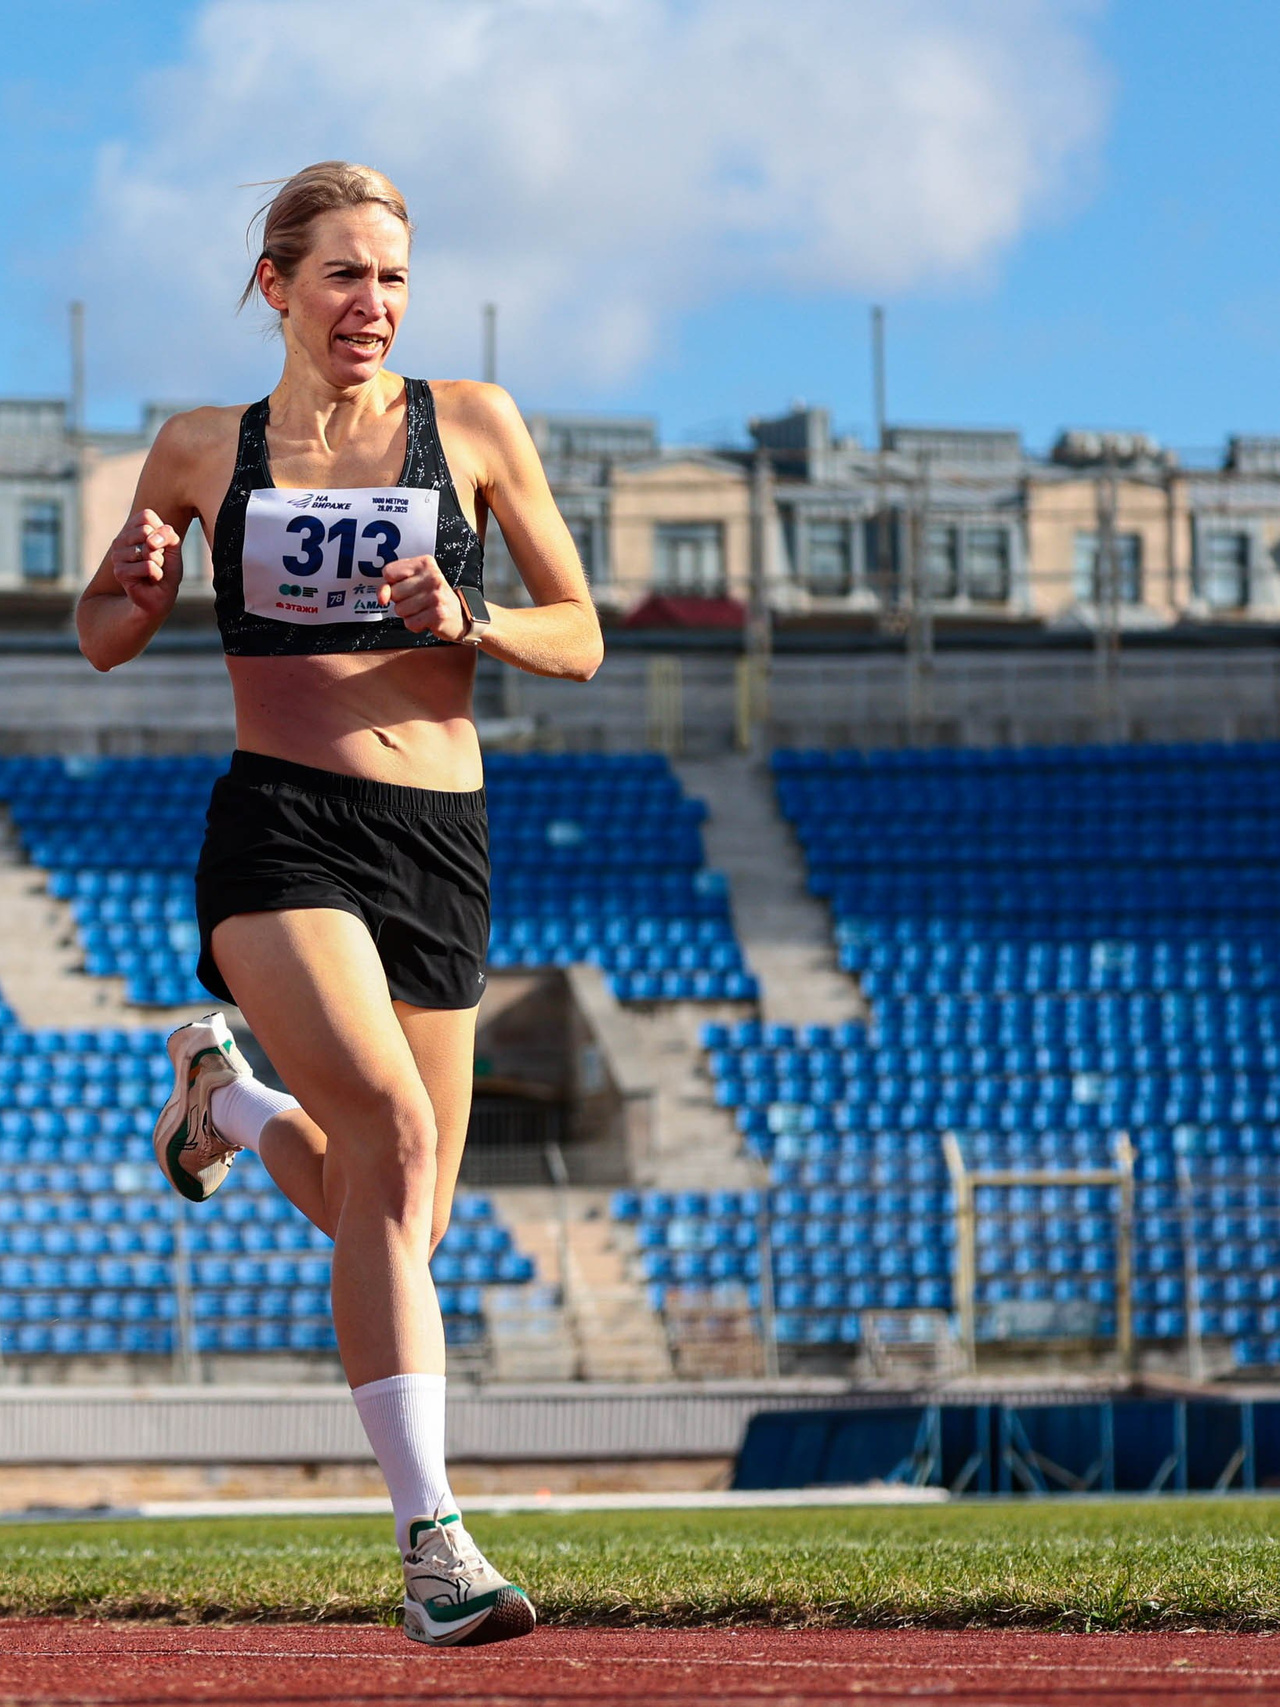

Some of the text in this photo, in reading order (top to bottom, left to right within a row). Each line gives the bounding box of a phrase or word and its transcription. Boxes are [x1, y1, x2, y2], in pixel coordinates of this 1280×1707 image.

[311, 502, 352, 510] ВИРАЖЕ
[385, 498, 409, 506] МЕТРОВ
[282, 515, 401, 578] 313
[330, 594, 342, 605] 78
